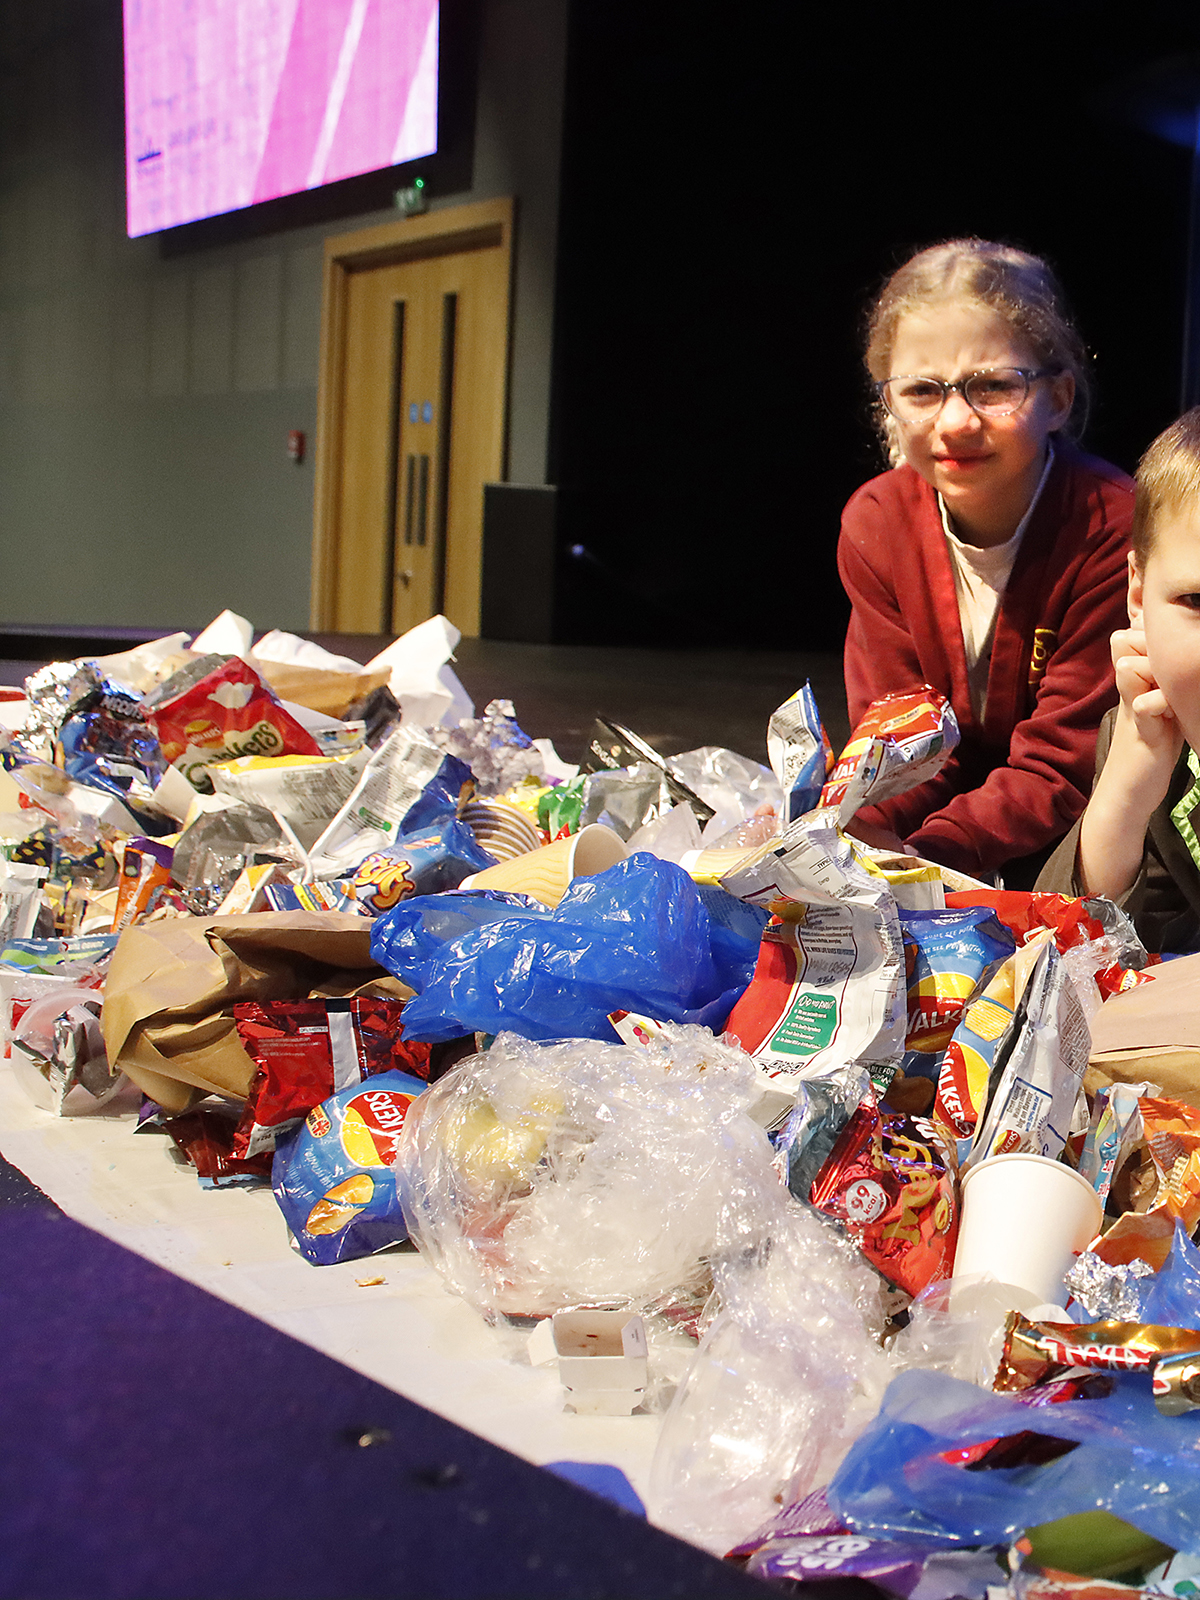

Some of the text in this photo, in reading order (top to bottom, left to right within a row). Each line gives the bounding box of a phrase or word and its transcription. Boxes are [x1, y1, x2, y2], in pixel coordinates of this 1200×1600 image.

[1015, 1092, 1035, 1129] big on flavour
[850, 1185, 878, 1216] 99 kcal
